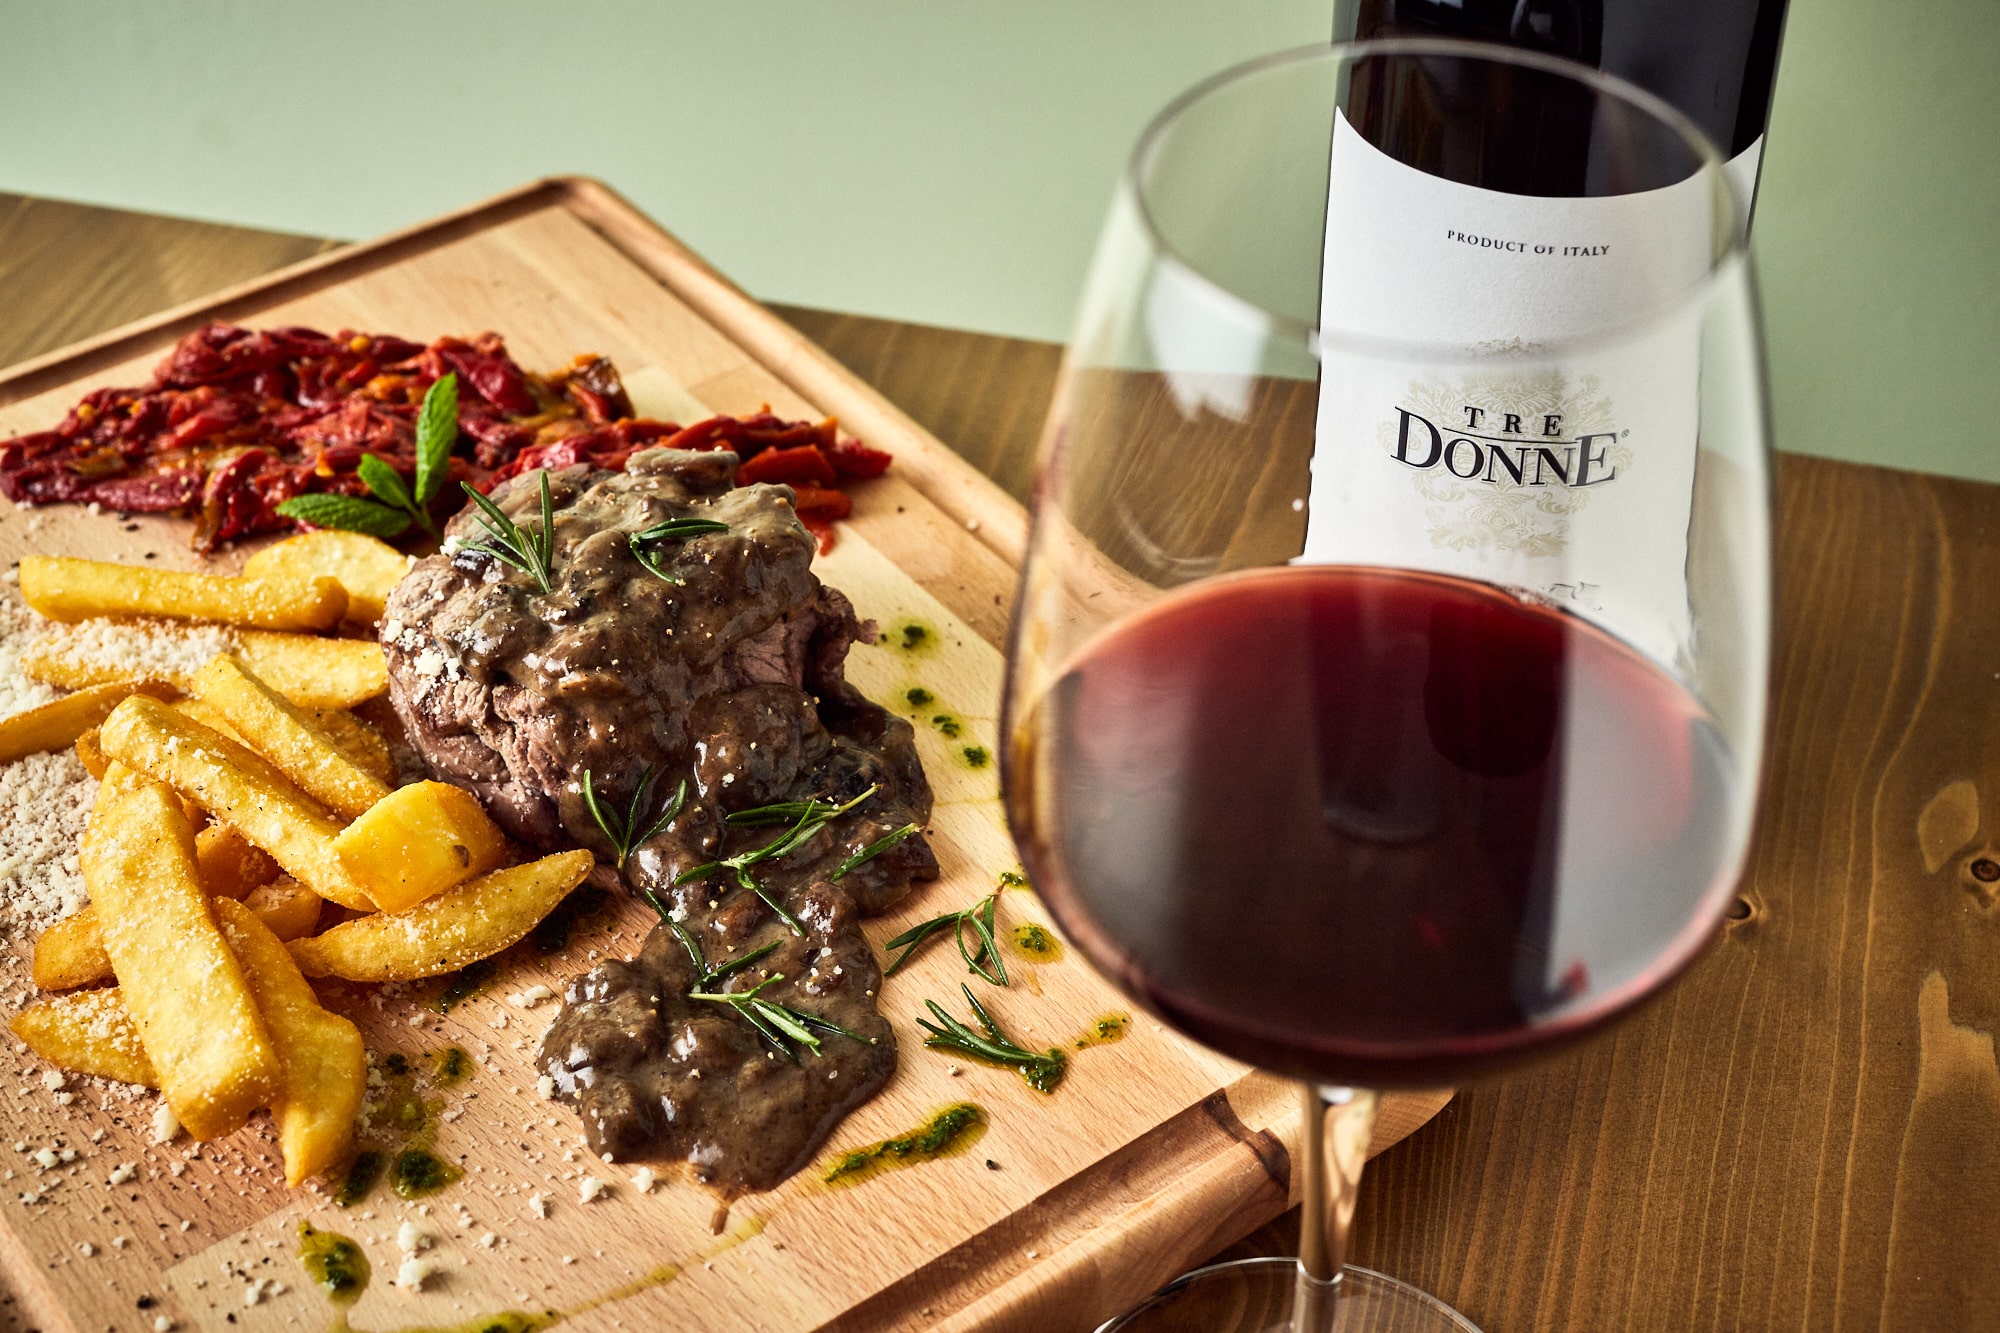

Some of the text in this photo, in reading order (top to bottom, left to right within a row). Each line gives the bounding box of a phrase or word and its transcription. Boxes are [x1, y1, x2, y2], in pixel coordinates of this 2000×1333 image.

[1447, 230, 1610, 257] PRODUCT OF ITALY
[1464, 405, 1562, 436] TRE
[1390, 406, 1617, 488] DONNE
